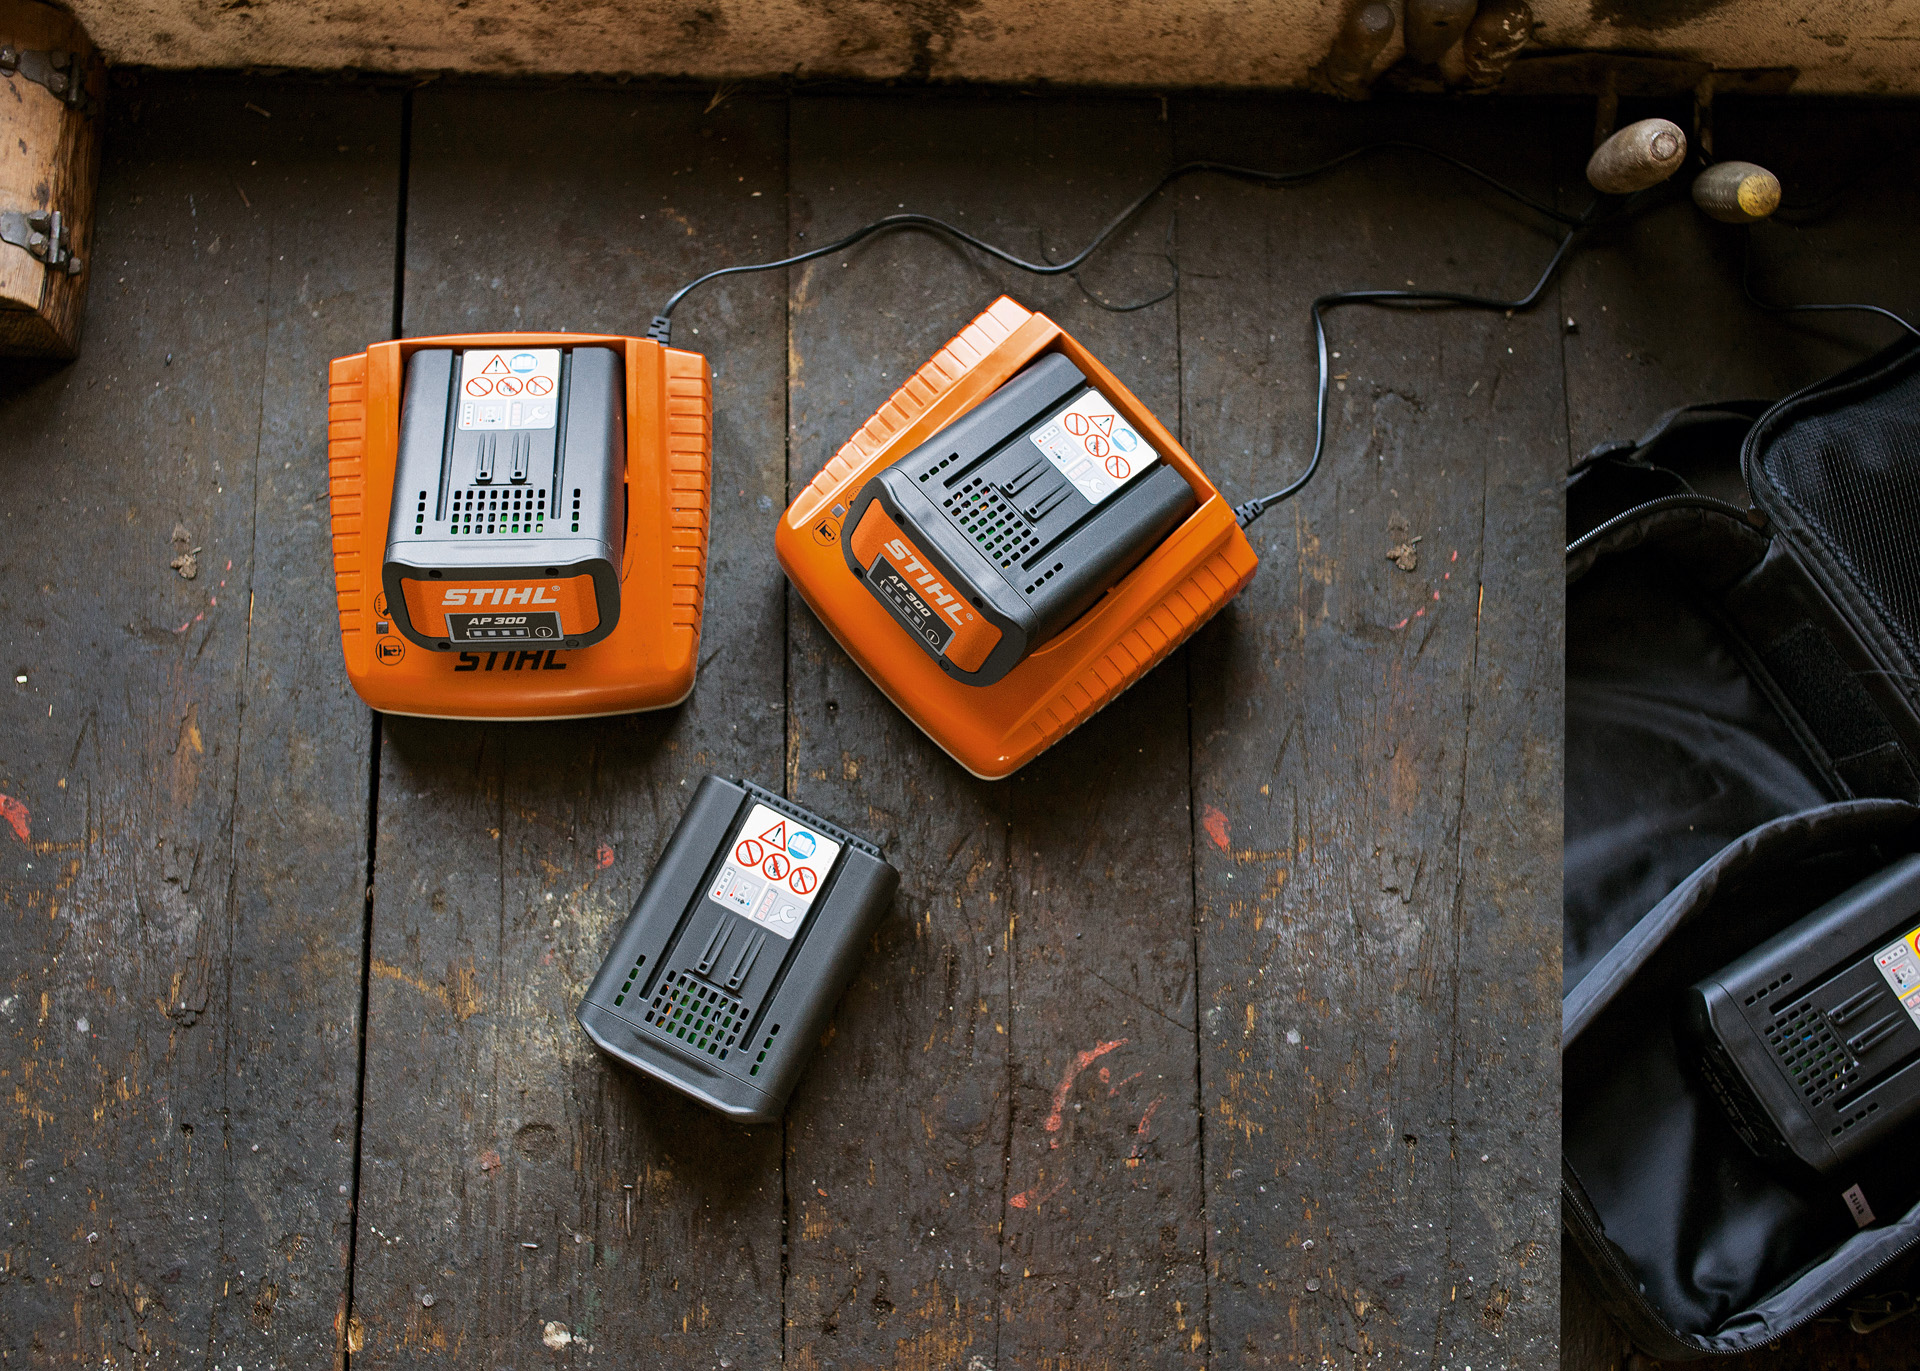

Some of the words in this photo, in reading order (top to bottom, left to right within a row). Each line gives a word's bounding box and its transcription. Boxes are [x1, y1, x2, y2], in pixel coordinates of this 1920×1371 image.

[888, 575, 908, 592] AP
[905, 593, 931, 617] 300
[468, 617, 492, 626] AP
[494, 616, 527, 625] 300
